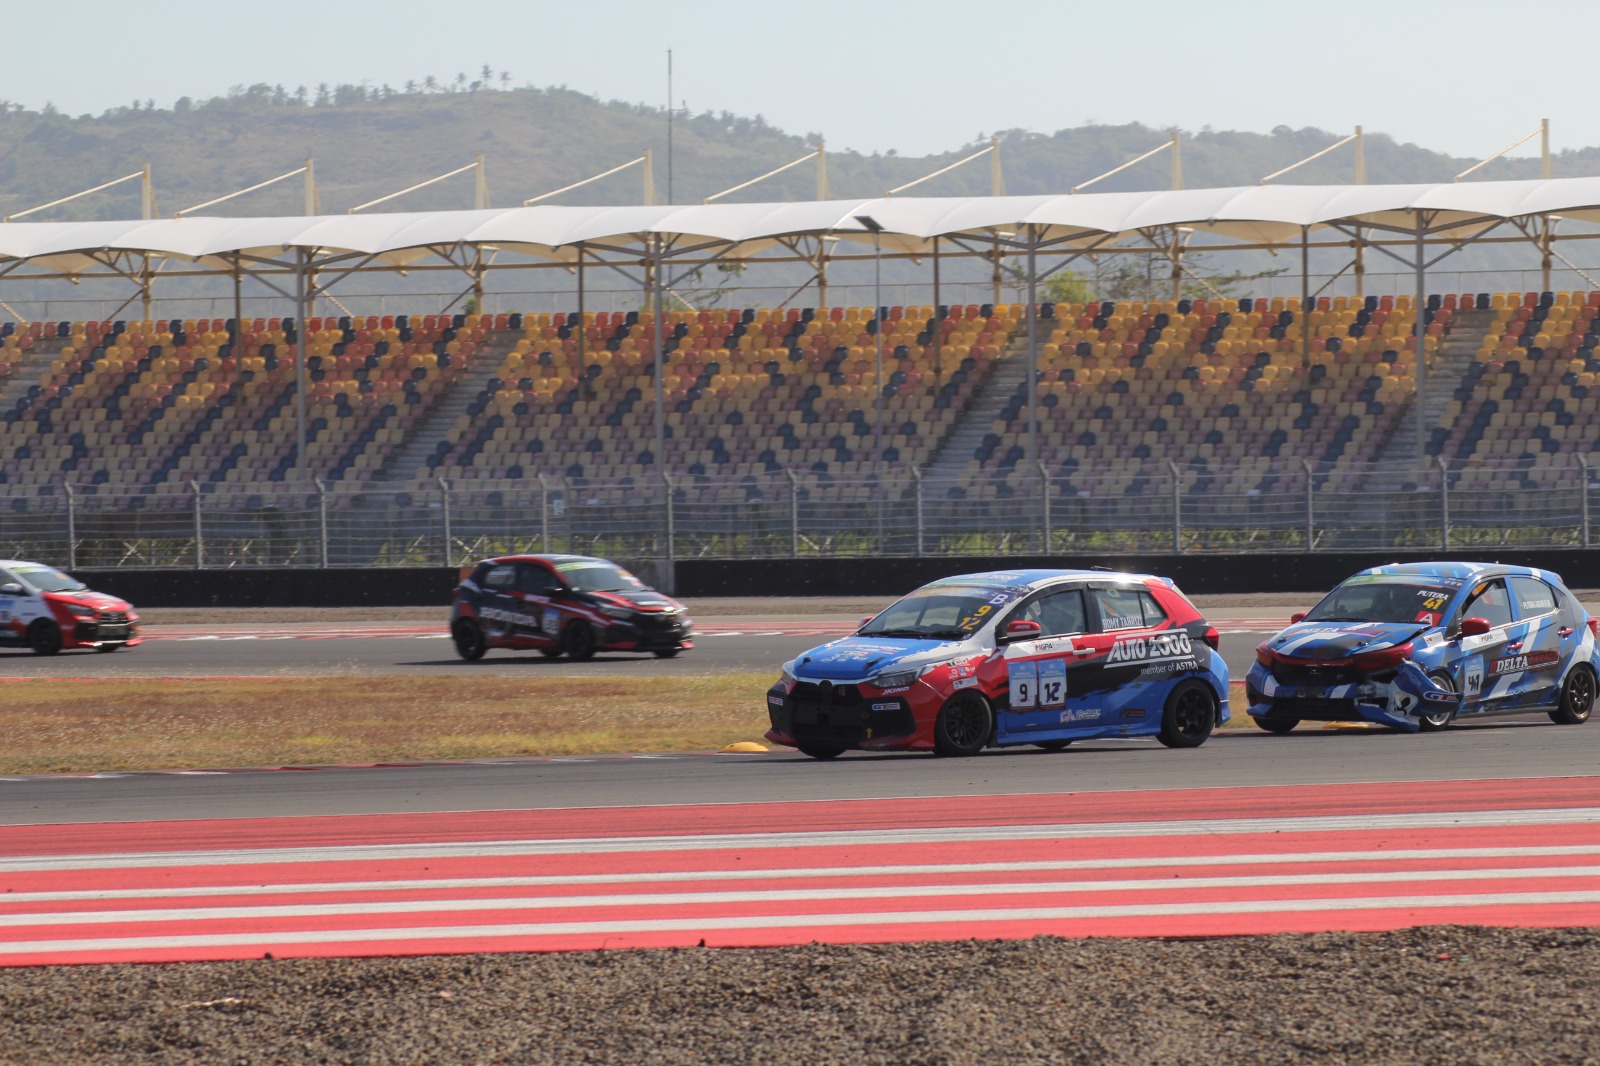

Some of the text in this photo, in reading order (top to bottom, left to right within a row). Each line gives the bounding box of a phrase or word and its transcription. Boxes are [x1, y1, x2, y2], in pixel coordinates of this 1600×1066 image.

[989, 593, 1009, 605] B
[1417, 590, 1449, 601] PUTERA
[1423, 597, 1444, 610] 41
[479, 606, 538, 627] HONDA
[974, 605, 992, 617] 9
[957, 617, 981, 631] 12
[1418, 613, 1433, 627] A
[1106, 633, 1192, 662] AUTO 2000
[1141, 660, 1199, 676] member of ASTRA
[1496, 655, 1529, 673] DELTA
[1020, 683, 1028, 703] 9
